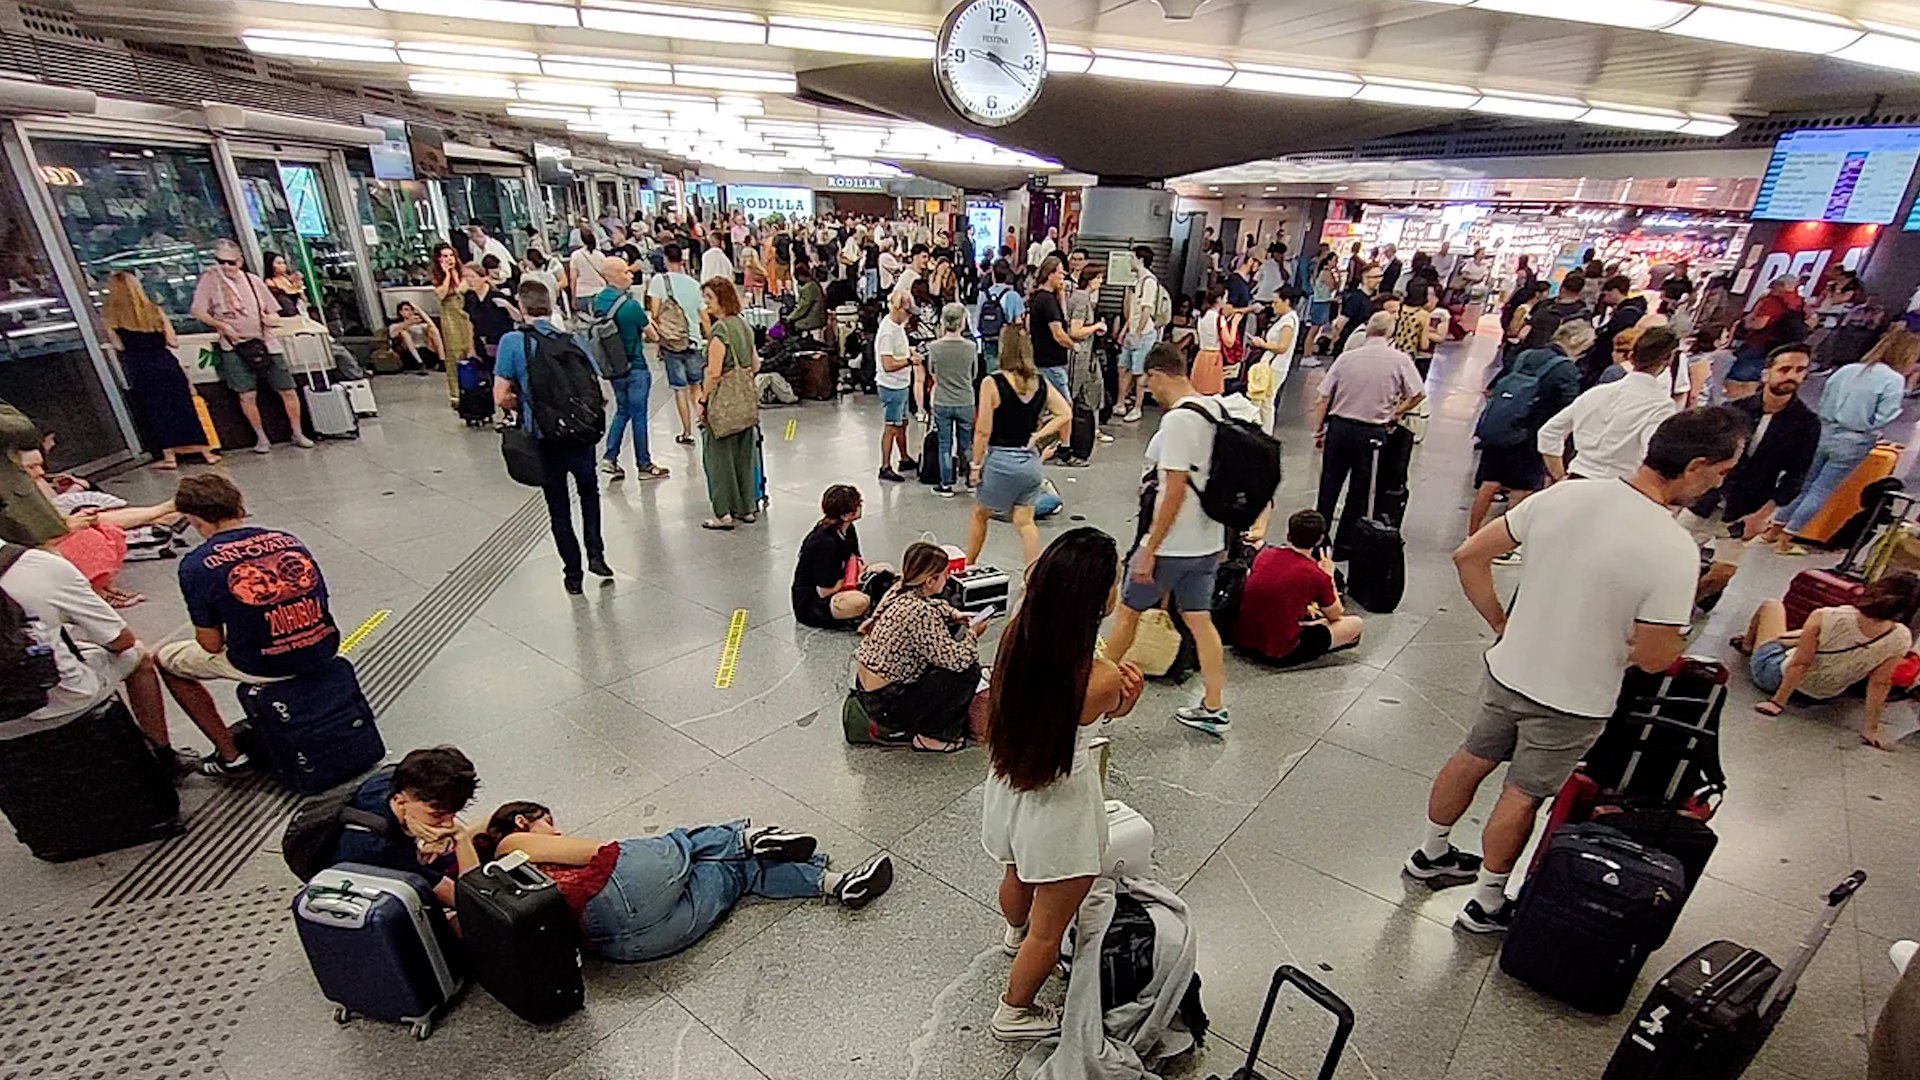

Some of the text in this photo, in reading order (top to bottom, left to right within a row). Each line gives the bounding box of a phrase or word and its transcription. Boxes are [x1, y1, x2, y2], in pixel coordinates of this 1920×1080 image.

[989, 7, 1007, 23] 12
[982, 35, 1009, 44] FESTINA
[954, 49, 965, 63] 9
[1023, 55, 1034, 70] 3
[986, 95, 998, 109] 6
[827, 177, 882, 189] RODILLA
[736, 196, 804, 211] RODILLA
